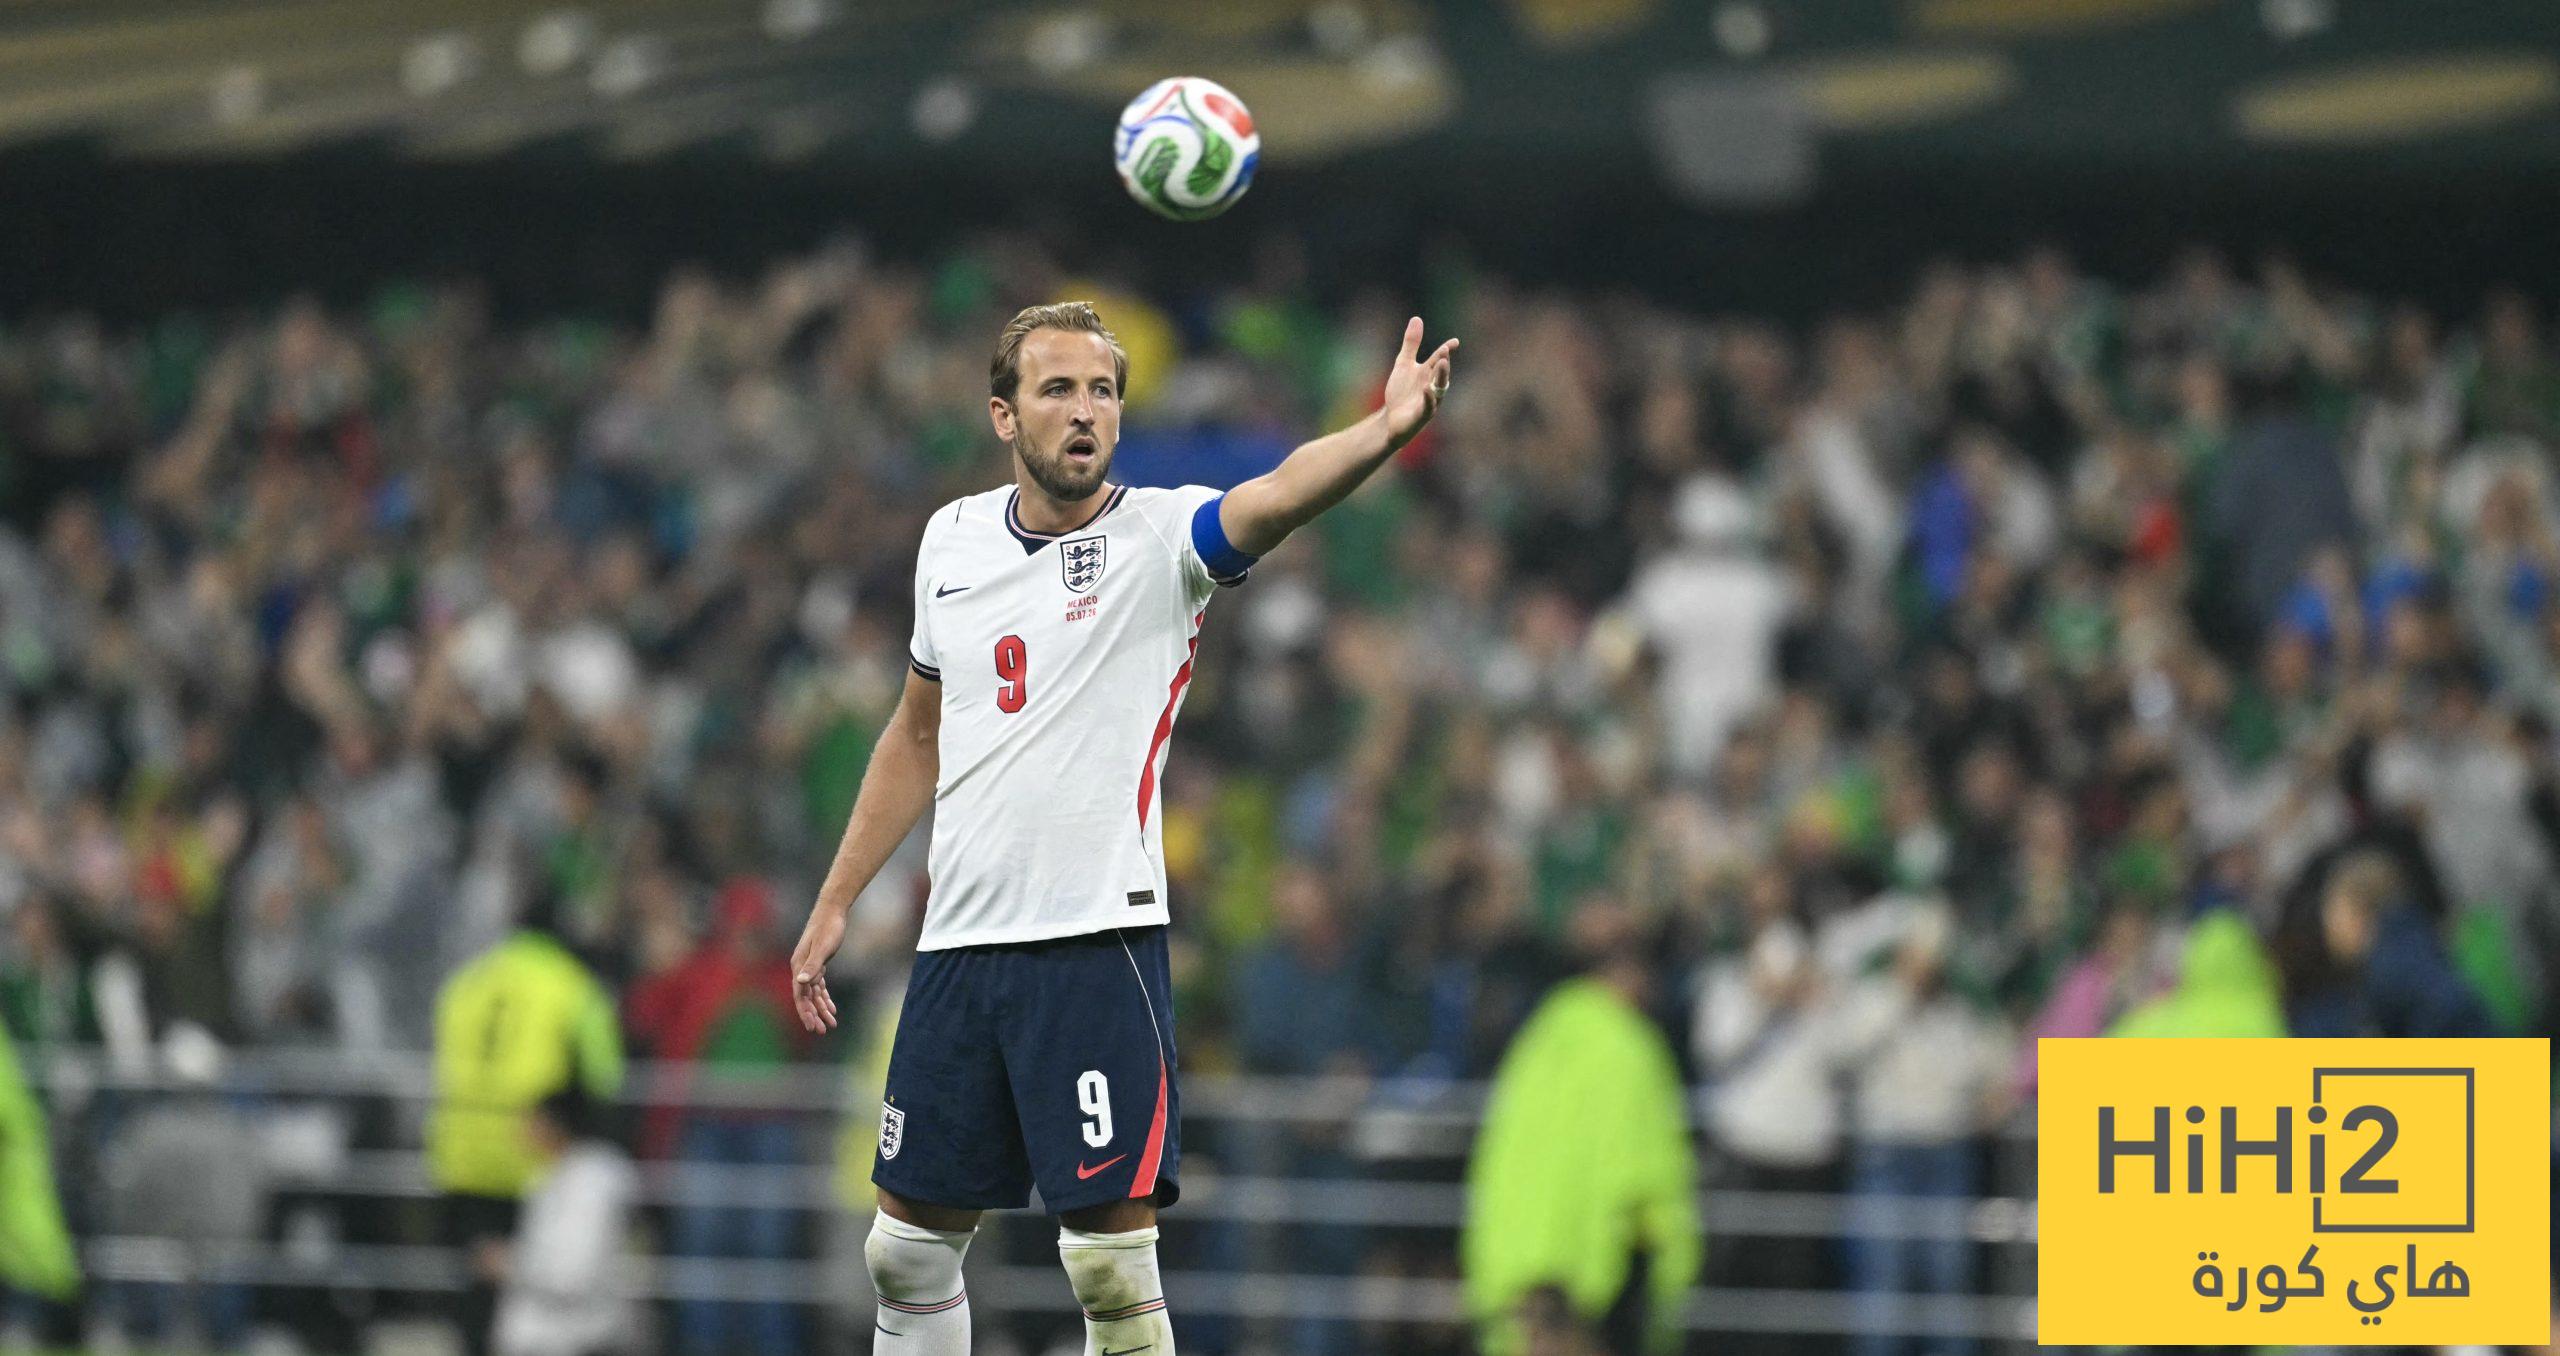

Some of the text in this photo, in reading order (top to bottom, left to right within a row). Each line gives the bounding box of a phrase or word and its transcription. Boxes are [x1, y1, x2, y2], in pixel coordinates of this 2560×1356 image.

[1066, 608, 1097, 621] 05.07.26
[1067, 595, 1098, 608] MEXICO
[995, 635, 1027, 713] 9
[1077, 1070, 1113, 1147] 9
